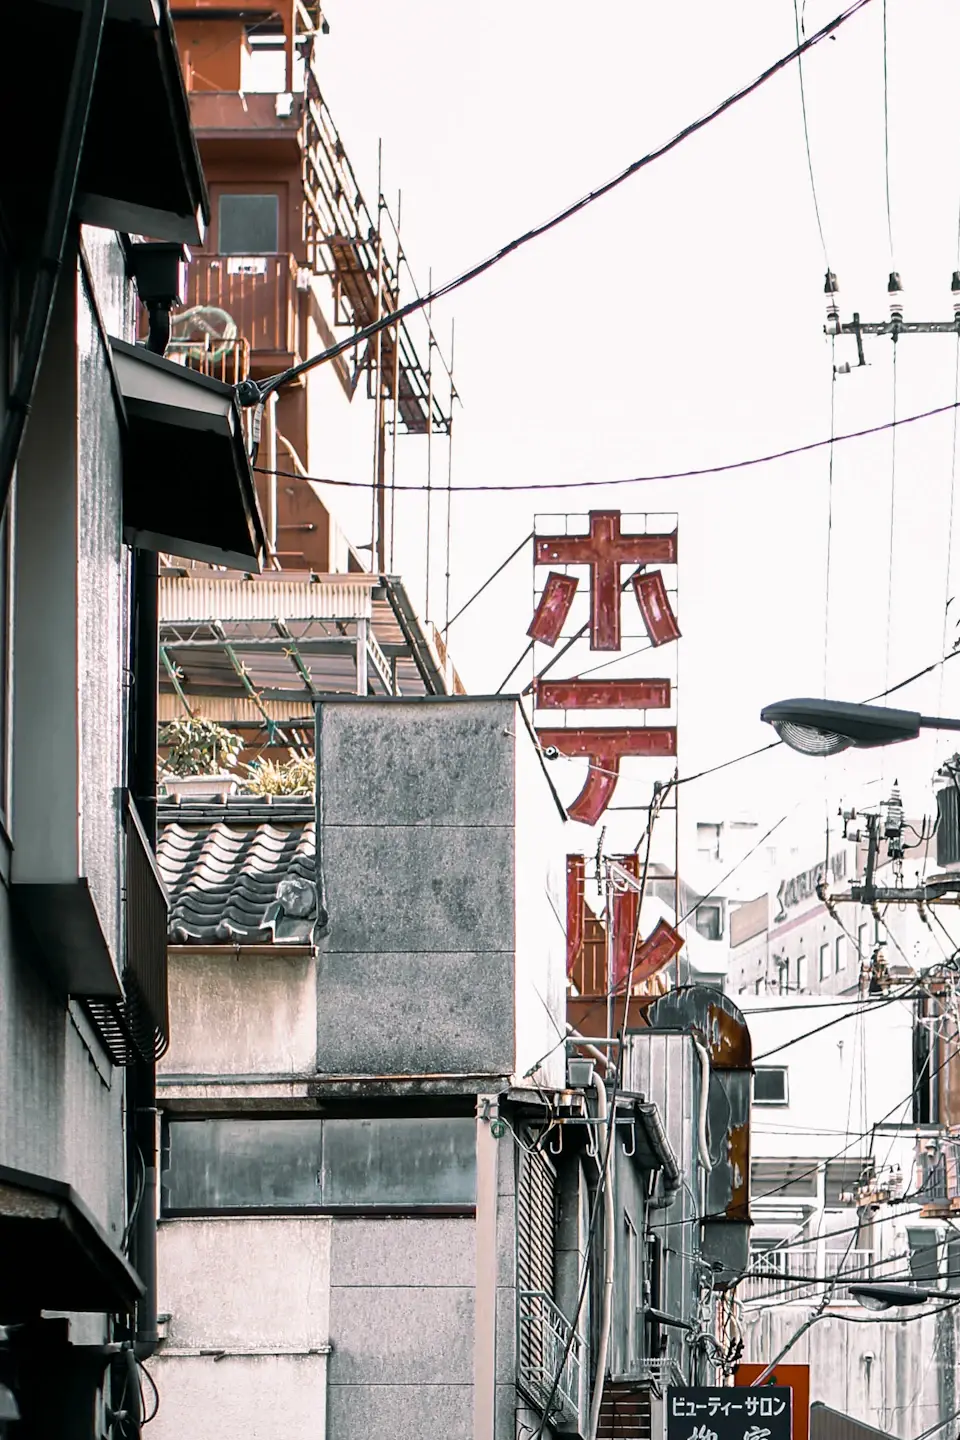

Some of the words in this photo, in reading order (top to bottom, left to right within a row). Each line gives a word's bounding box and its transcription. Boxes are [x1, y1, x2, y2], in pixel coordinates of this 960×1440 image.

[526, 509, 684, 996] ホテル
[672, 1396, 786, 1417] ビューティーサロン
